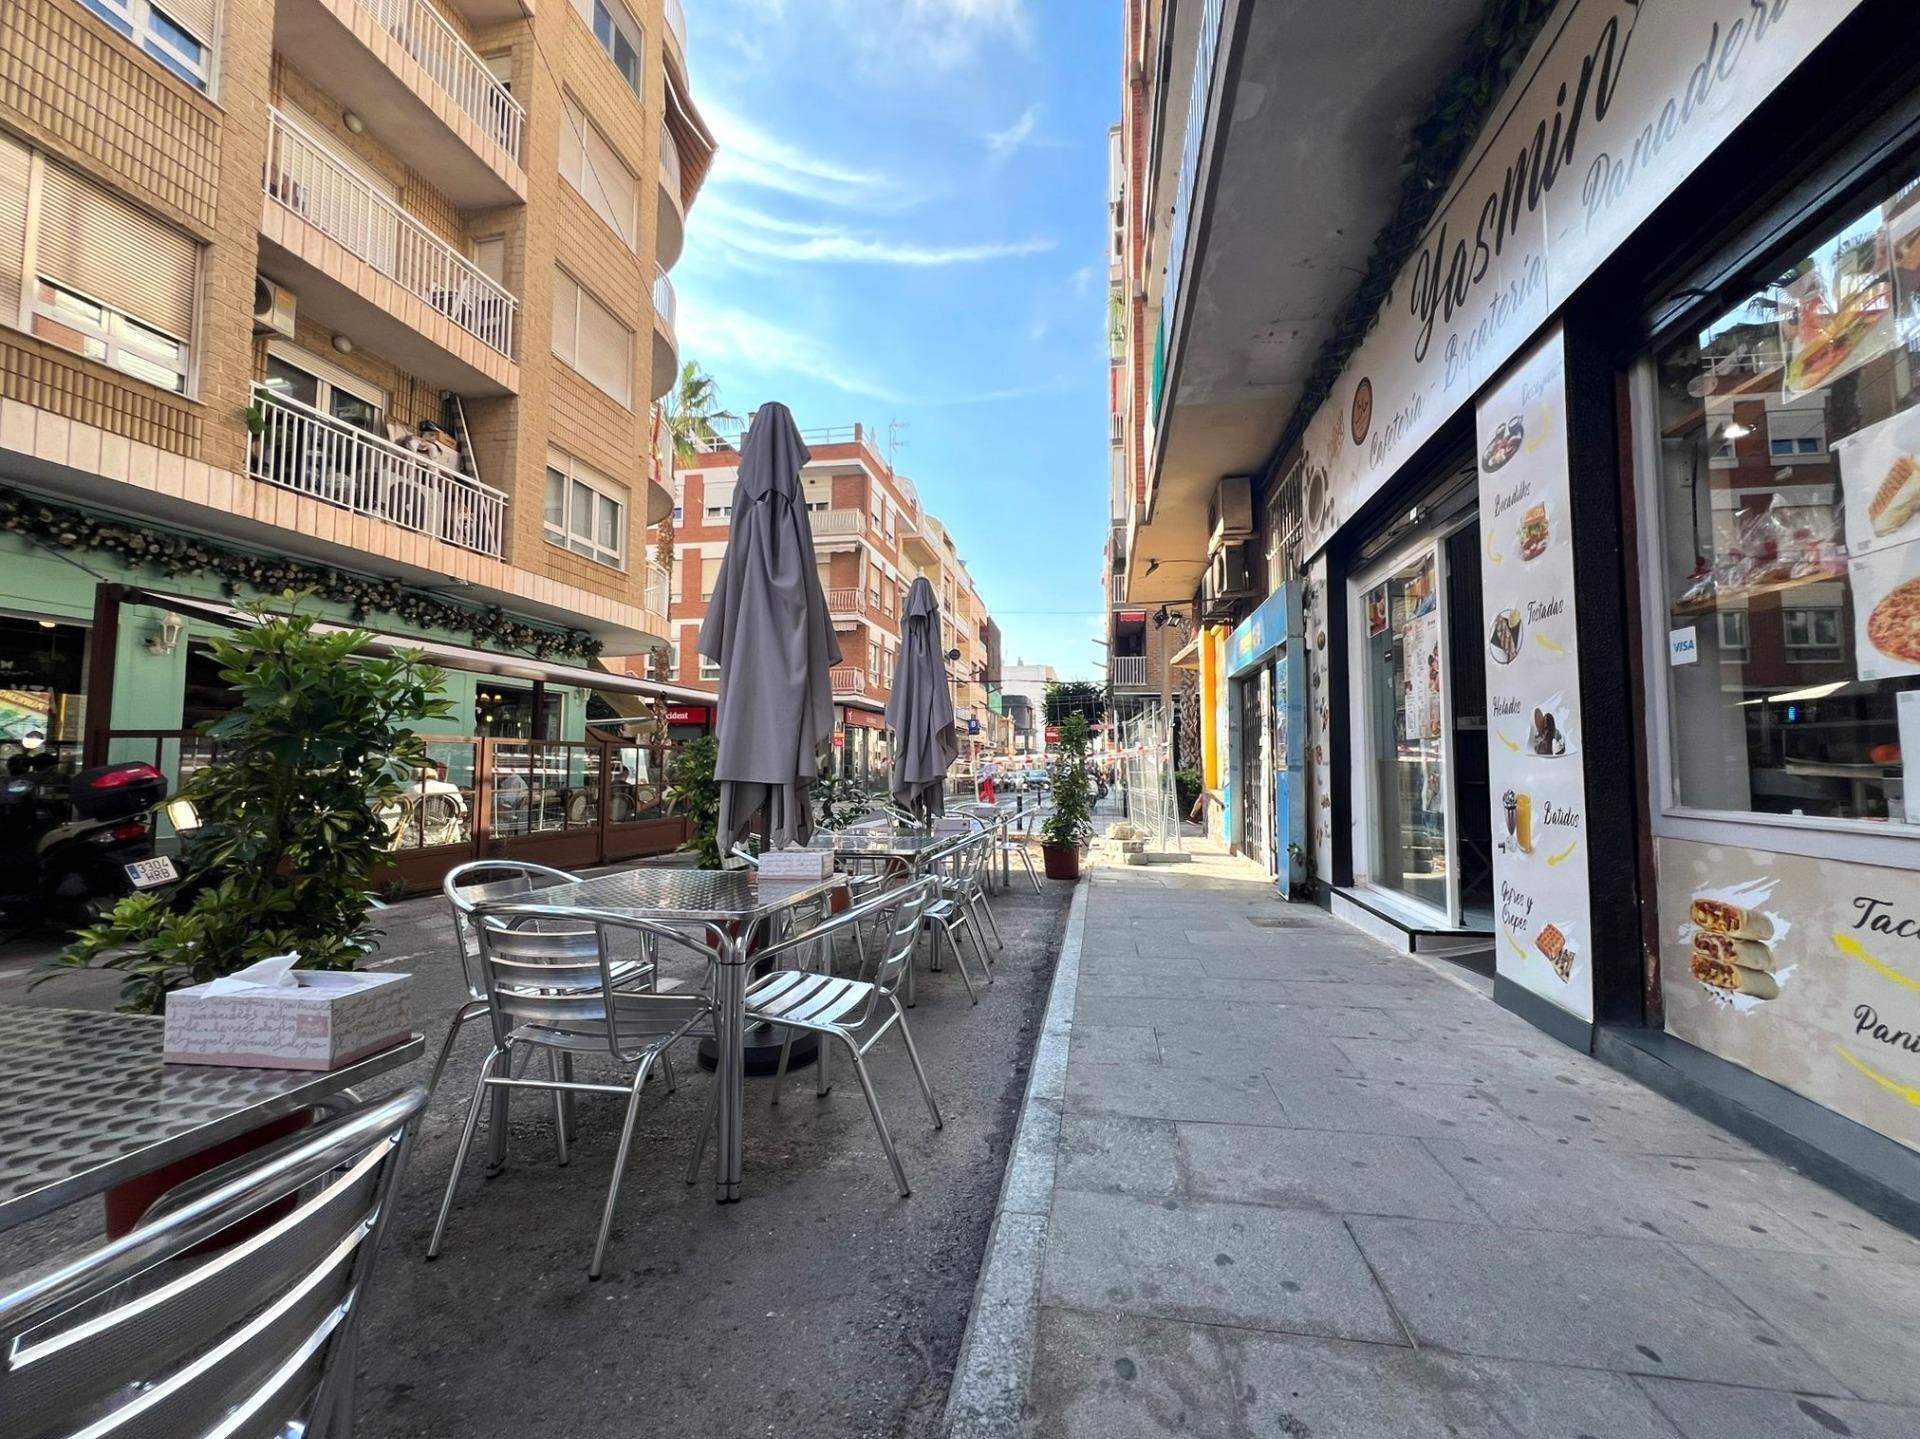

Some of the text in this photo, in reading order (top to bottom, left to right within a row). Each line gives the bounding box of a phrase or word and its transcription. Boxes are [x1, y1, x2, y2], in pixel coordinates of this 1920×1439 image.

[1410, 0, 1645, 364] Yasmin
[1527, 596, 1564, 626] Tostadas
[1673, 639, 1695, 653] VISA
[1492, 695, 1521, 717] Helados
[1543, 800, 1579, 828] Batidos
[145, 868, 170, 881] HRB
[1501, 903, 1527, 934] Crepes
[1852, 896, 1920, 940] Tac
